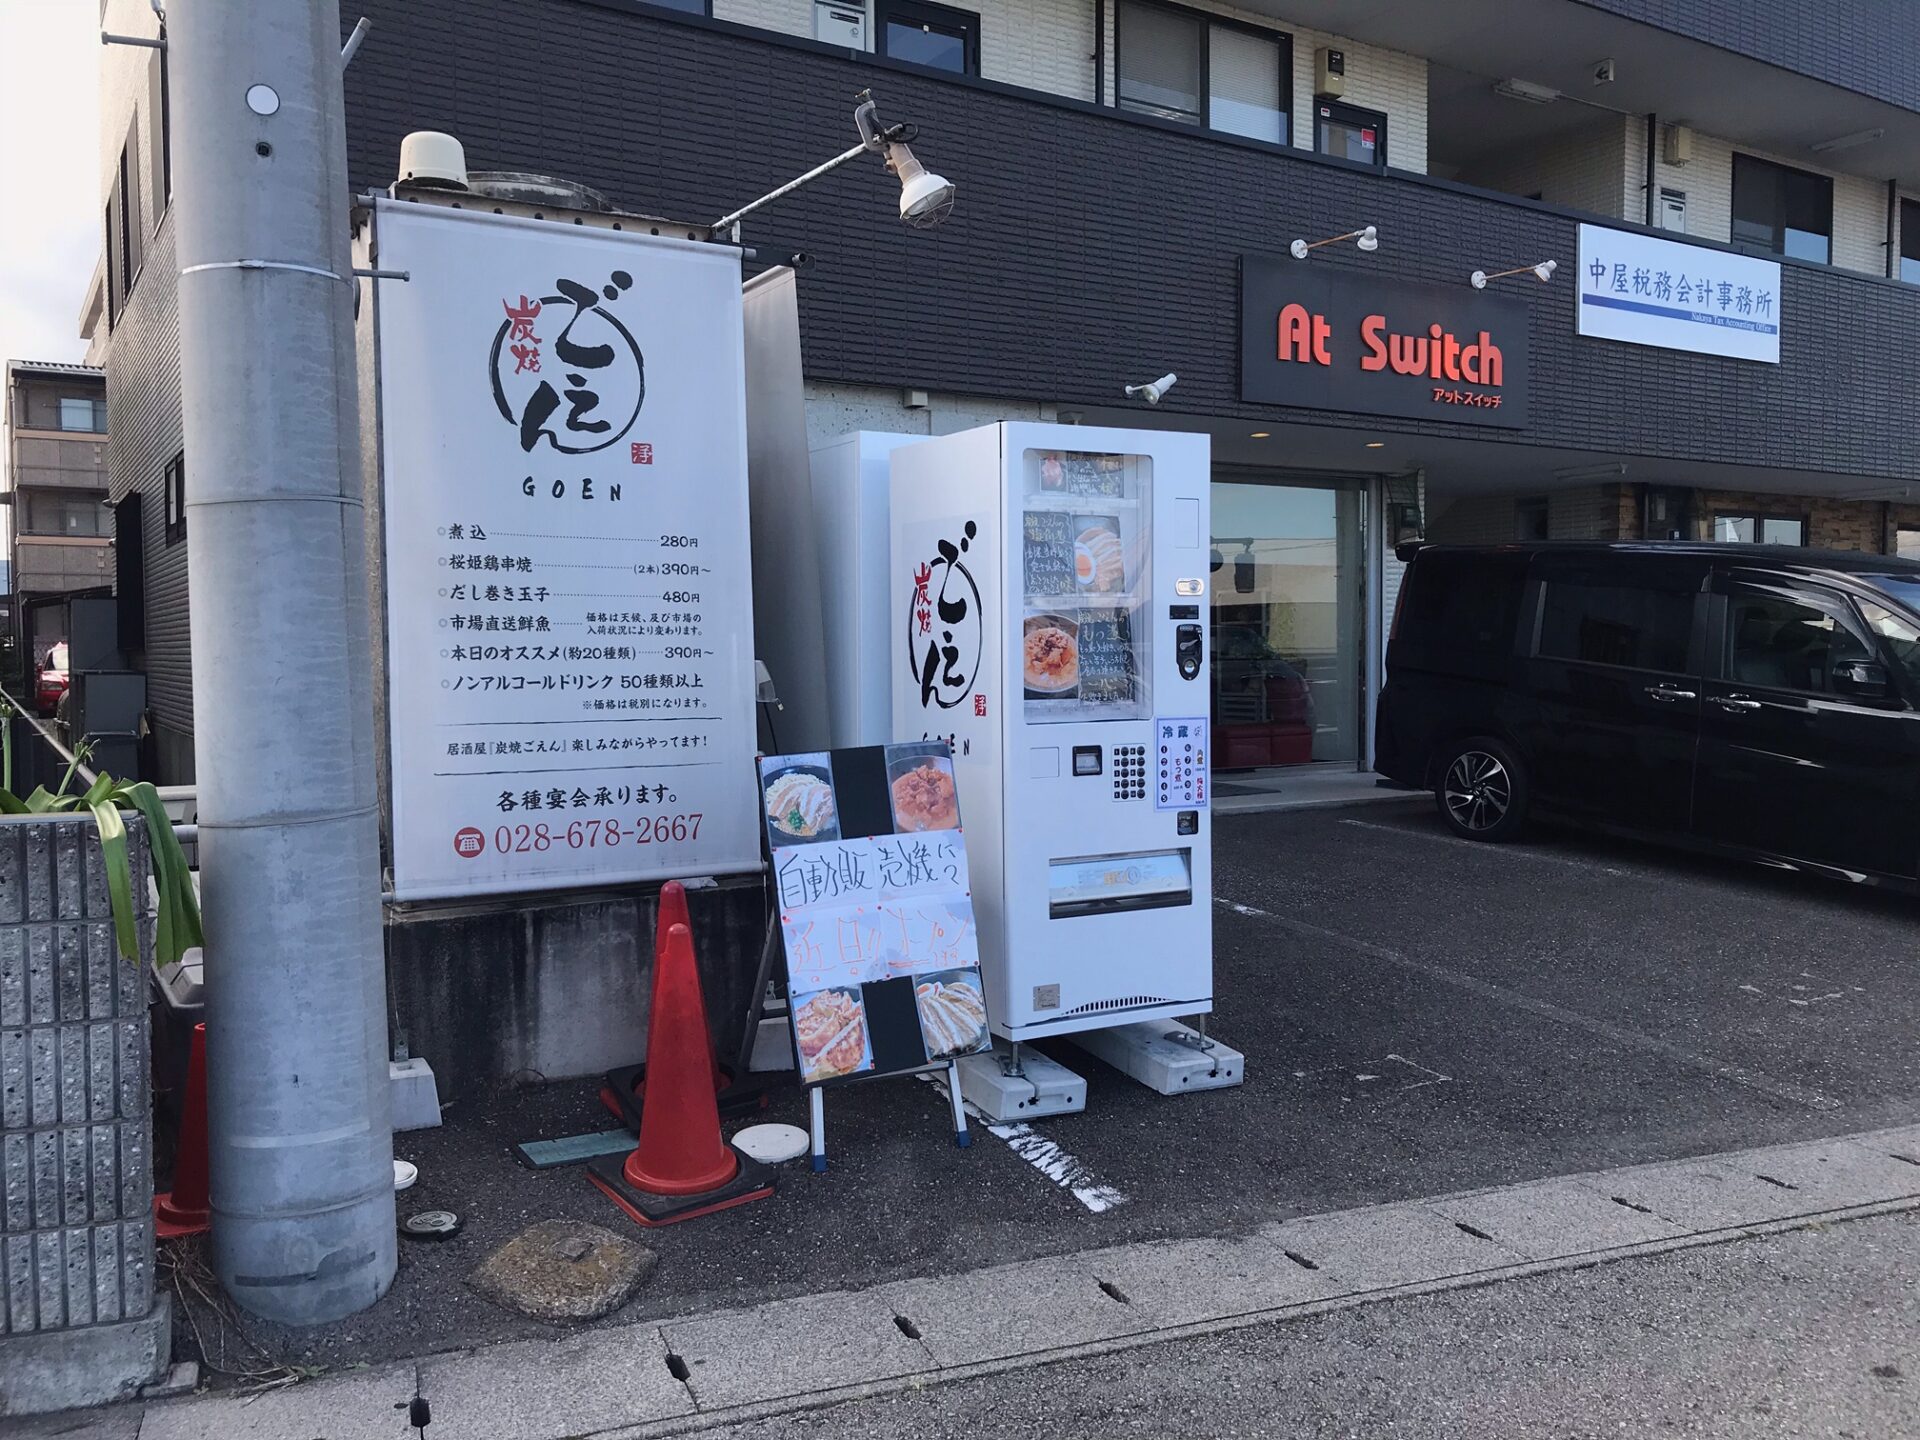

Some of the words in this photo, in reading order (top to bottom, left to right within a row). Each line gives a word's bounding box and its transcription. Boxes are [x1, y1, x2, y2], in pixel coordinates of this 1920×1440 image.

[1589, 257, 1773, 319] 中屋税務会計事務所
[1278, 303, 1331, 366] At
[1361, 314, 1503, 387] Switch
[1432, 388, 1503, 409] アットスイッチ
[523, 475, 622, 501] GOEN
[659, 535, 699, 548] 280円
[448, 554, 533, 573] 桜姫鶏串焼
[449, 584, 551, 602] だし巻き玉子
[662, 591, 700, 603] 480円
[449, 614, 551, 632] 市場直送鮮魚
[452, 673, 615, 691] ノンアルコールドリンク
[620, 673, 704, 690] 50種類以上
[495, 783, 678, 812] 各種宴会承ります。
[494, 813, 704, 854] 028-678-2667
